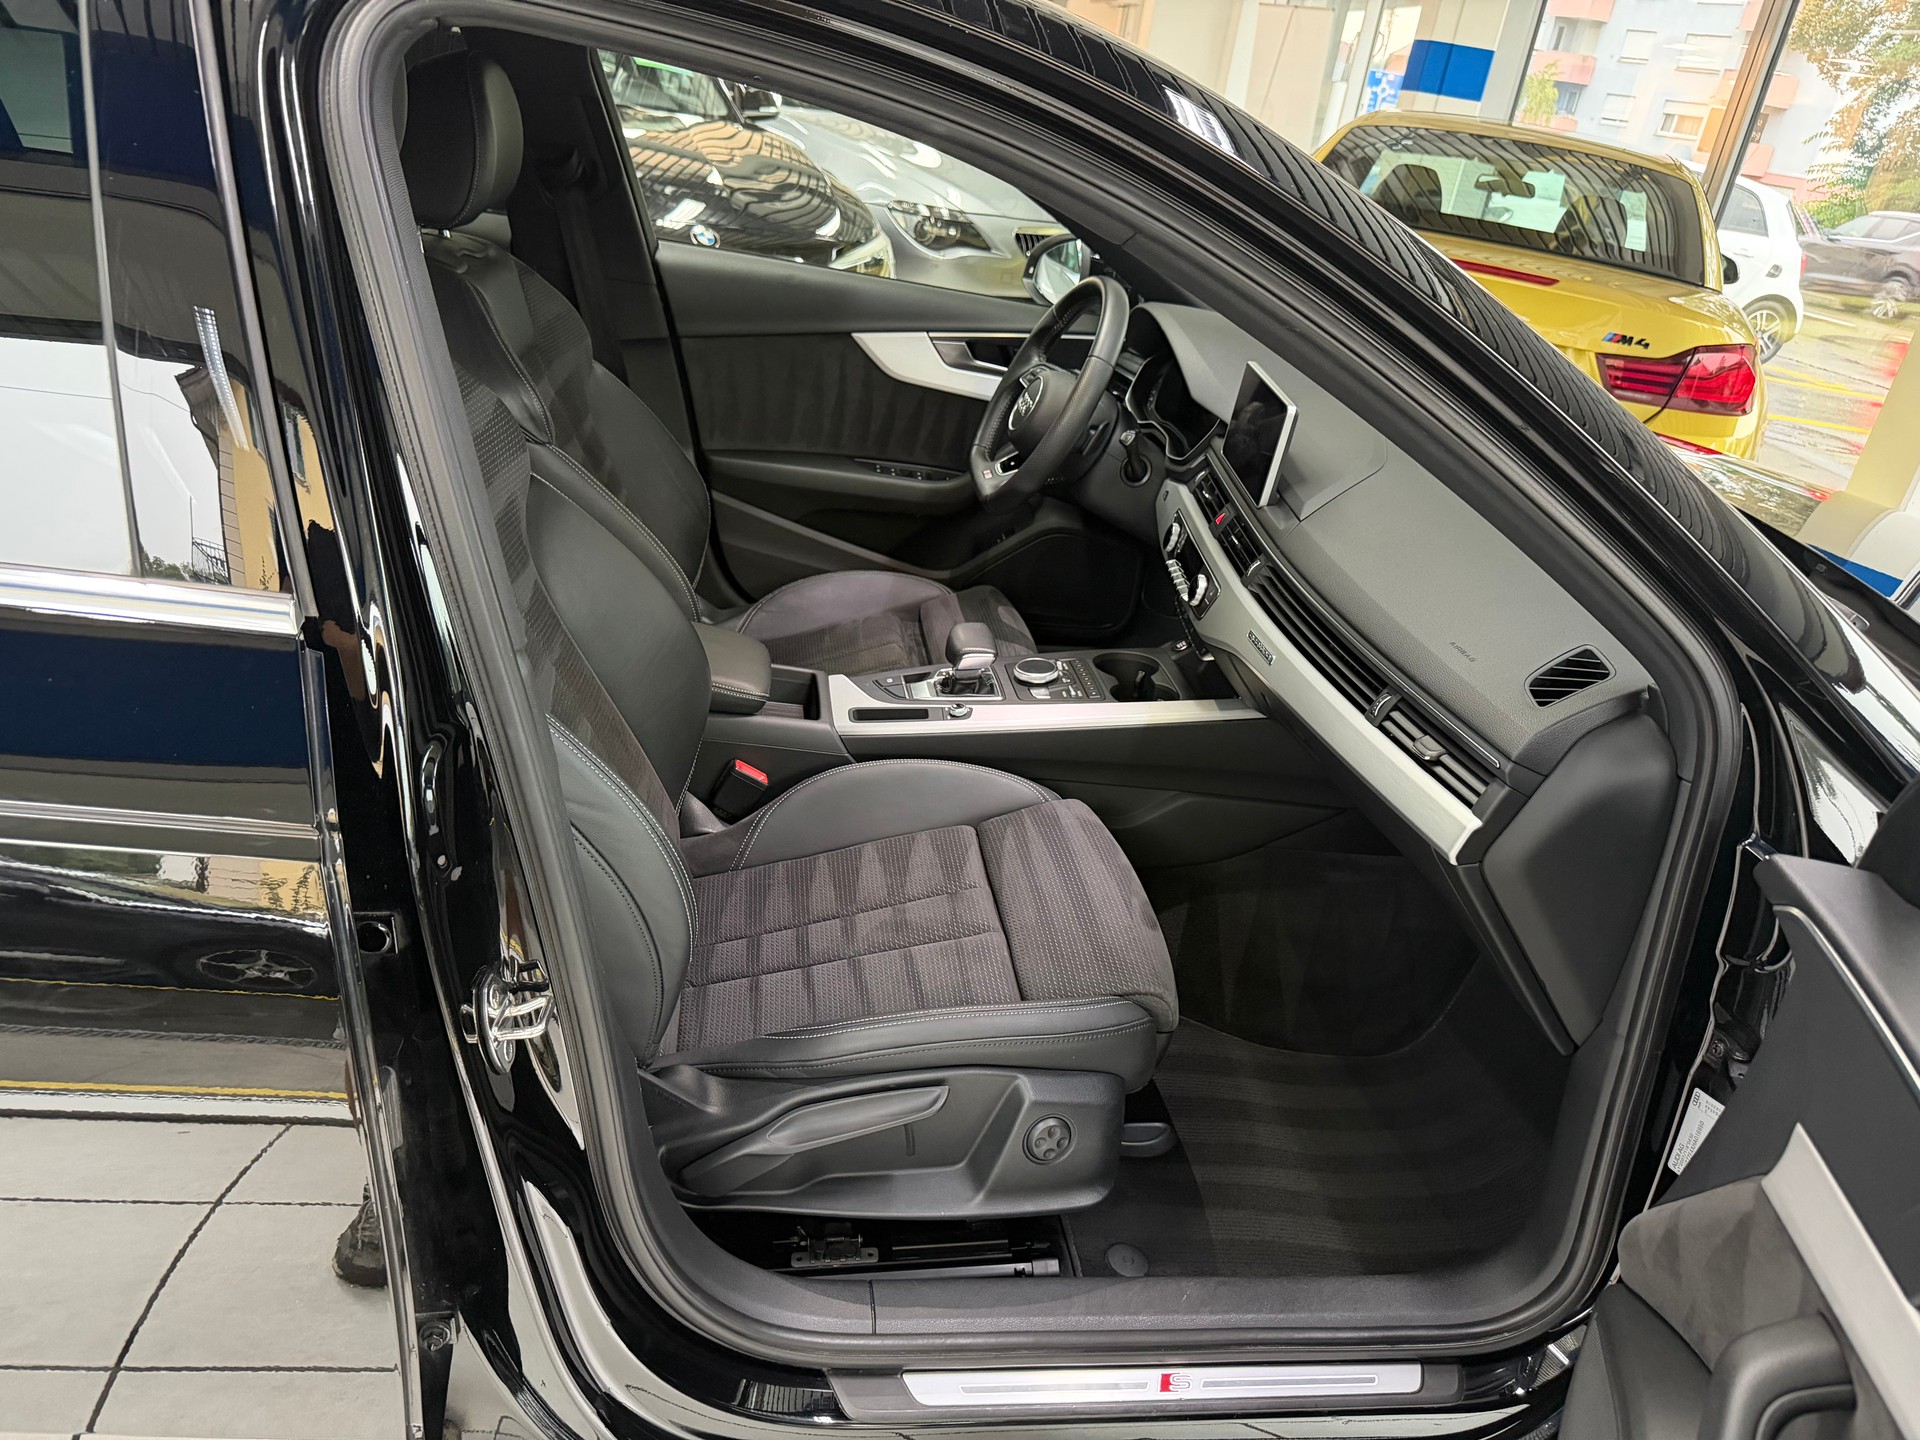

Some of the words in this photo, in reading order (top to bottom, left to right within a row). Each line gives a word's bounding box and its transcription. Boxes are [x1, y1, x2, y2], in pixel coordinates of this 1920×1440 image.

[1609, 333, 1650, 350] M4
[1672, 1151, 1681, 1169] AUDI
[1677, 1142, 1685, 1155] AG
[1167, 1372, 1193, 1392] S
